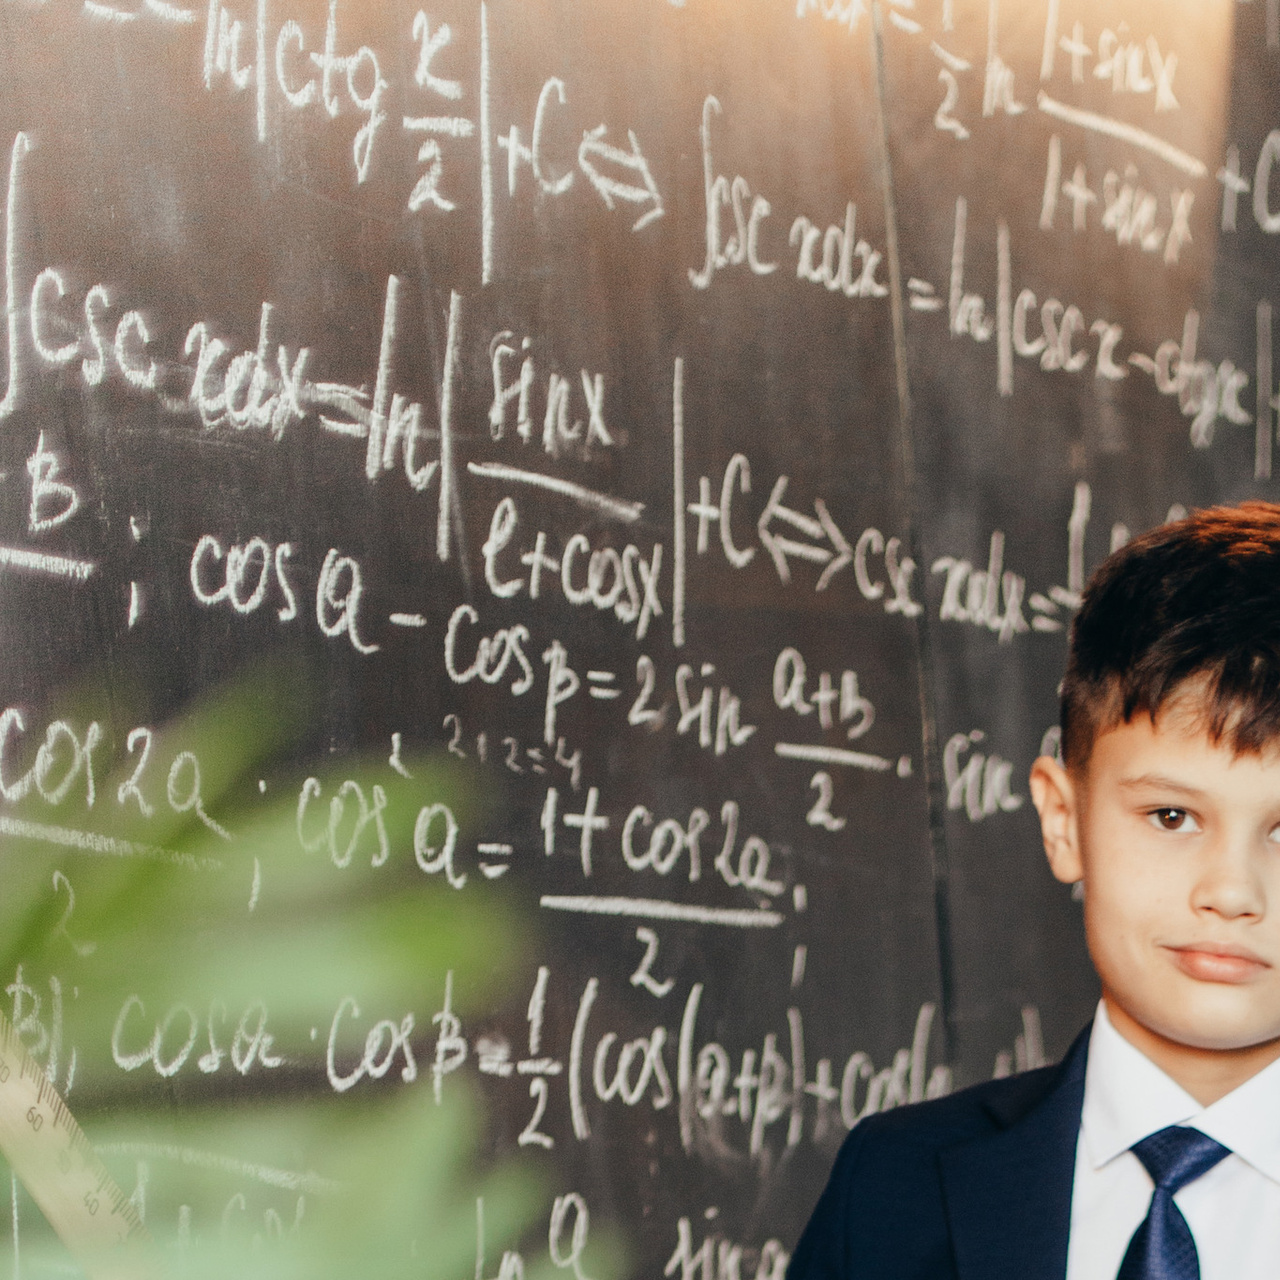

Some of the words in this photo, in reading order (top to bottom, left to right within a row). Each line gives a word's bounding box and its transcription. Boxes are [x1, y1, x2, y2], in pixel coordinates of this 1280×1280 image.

[806, 771, 847, 832] 2
[630, 926, 675, 997] 2
[517, 1077, 554, 1148] 2
[26, 1106, 43, 1132] 60
[83, 1190, 100, 1216] 40
